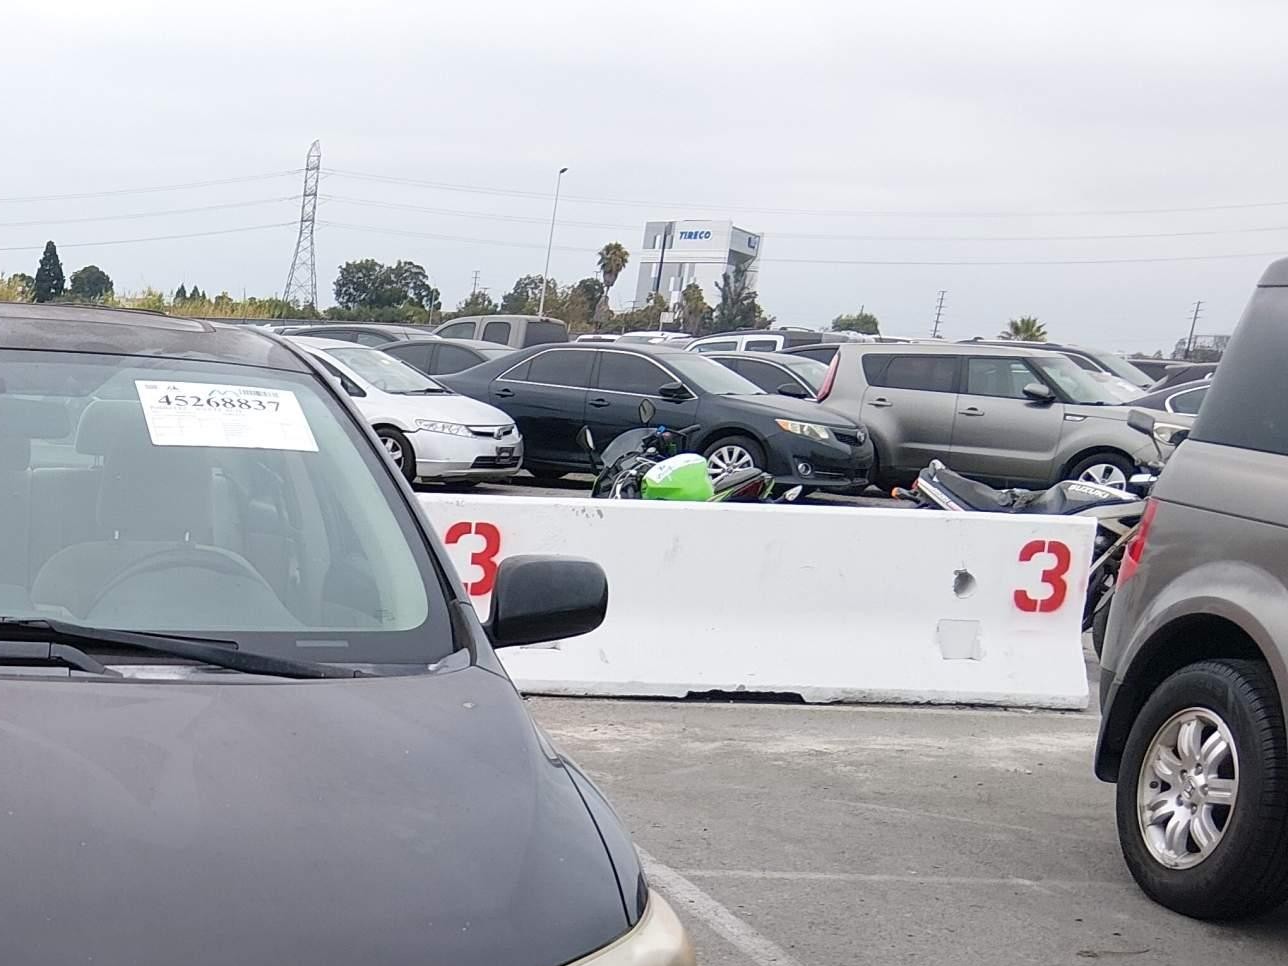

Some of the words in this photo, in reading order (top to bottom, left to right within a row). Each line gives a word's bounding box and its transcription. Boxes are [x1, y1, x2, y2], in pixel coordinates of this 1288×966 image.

[679, 230, 711, 240] TIRECO
[158, 394, 281, 412] 45268837
[1068, 484, 1110, 498] SUZUKI
[444, 521, 500, 596] 3
[1013, 540, 1071, 614] 3
